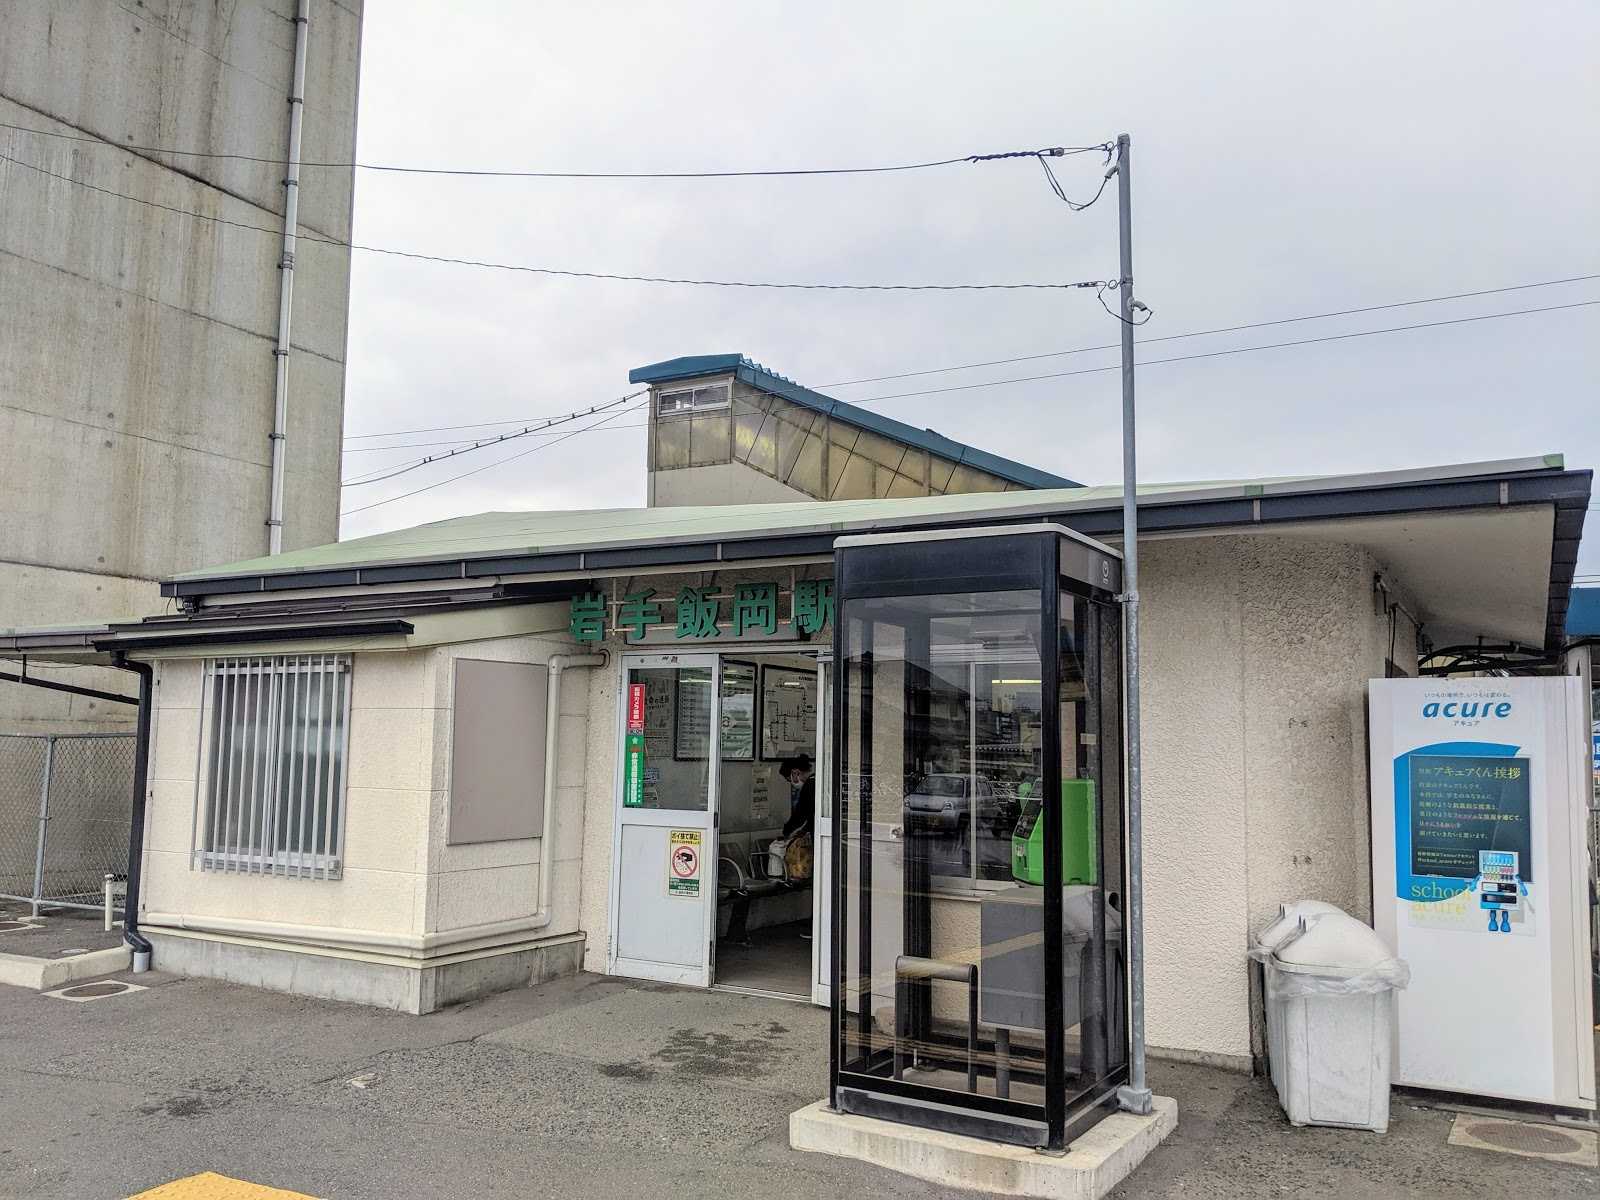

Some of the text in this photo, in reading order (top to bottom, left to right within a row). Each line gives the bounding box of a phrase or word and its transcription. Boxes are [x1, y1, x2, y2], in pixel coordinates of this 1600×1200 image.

[570, 580, 834, 642] 岩手飯岡駅
[1423, 702, 1512, 718] acure
[1411, 881, 1471, 900] school
